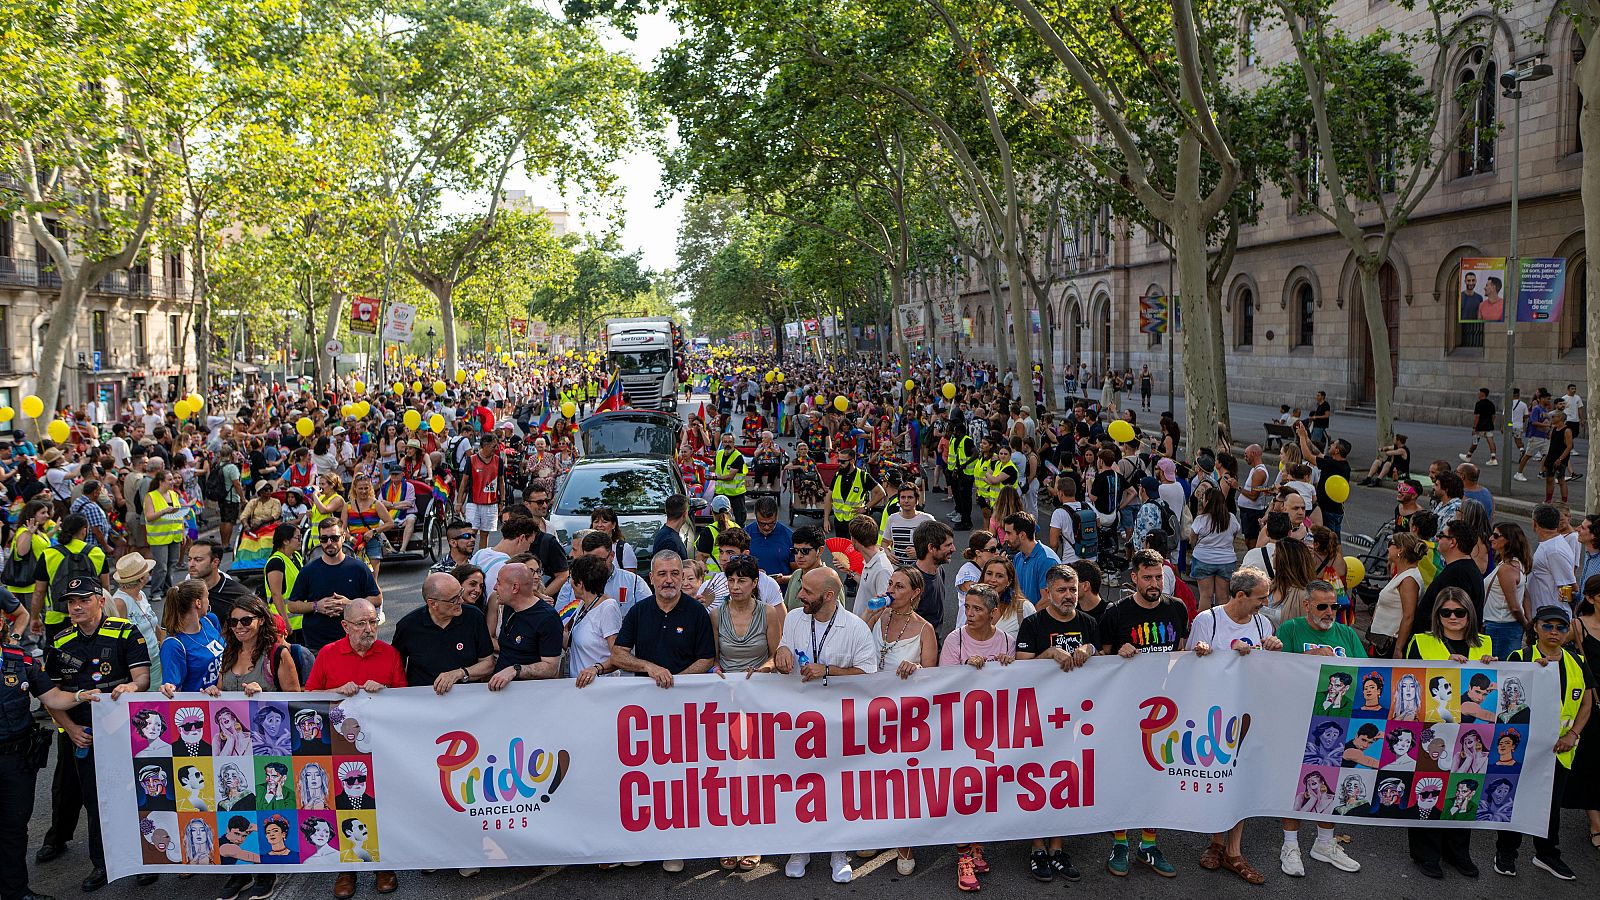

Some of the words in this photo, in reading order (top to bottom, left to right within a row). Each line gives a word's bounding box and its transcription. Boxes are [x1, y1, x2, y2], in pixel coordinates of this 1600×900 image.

[616, 702, 827, 766] Cultura
[1139, 696, 1251, 771] Pride!
[435, 730, 570, 812] Pride!
[619, 766, 828, 832] Cultura
[842, 748, 1095, 821] universal
[1168, 768, 1233, 778] BARCELONA
[1180, 781, 1224, 793] 2025
[470, 803, 541, 816] BARCELONA
[482, 817, 528, 830] 2025
